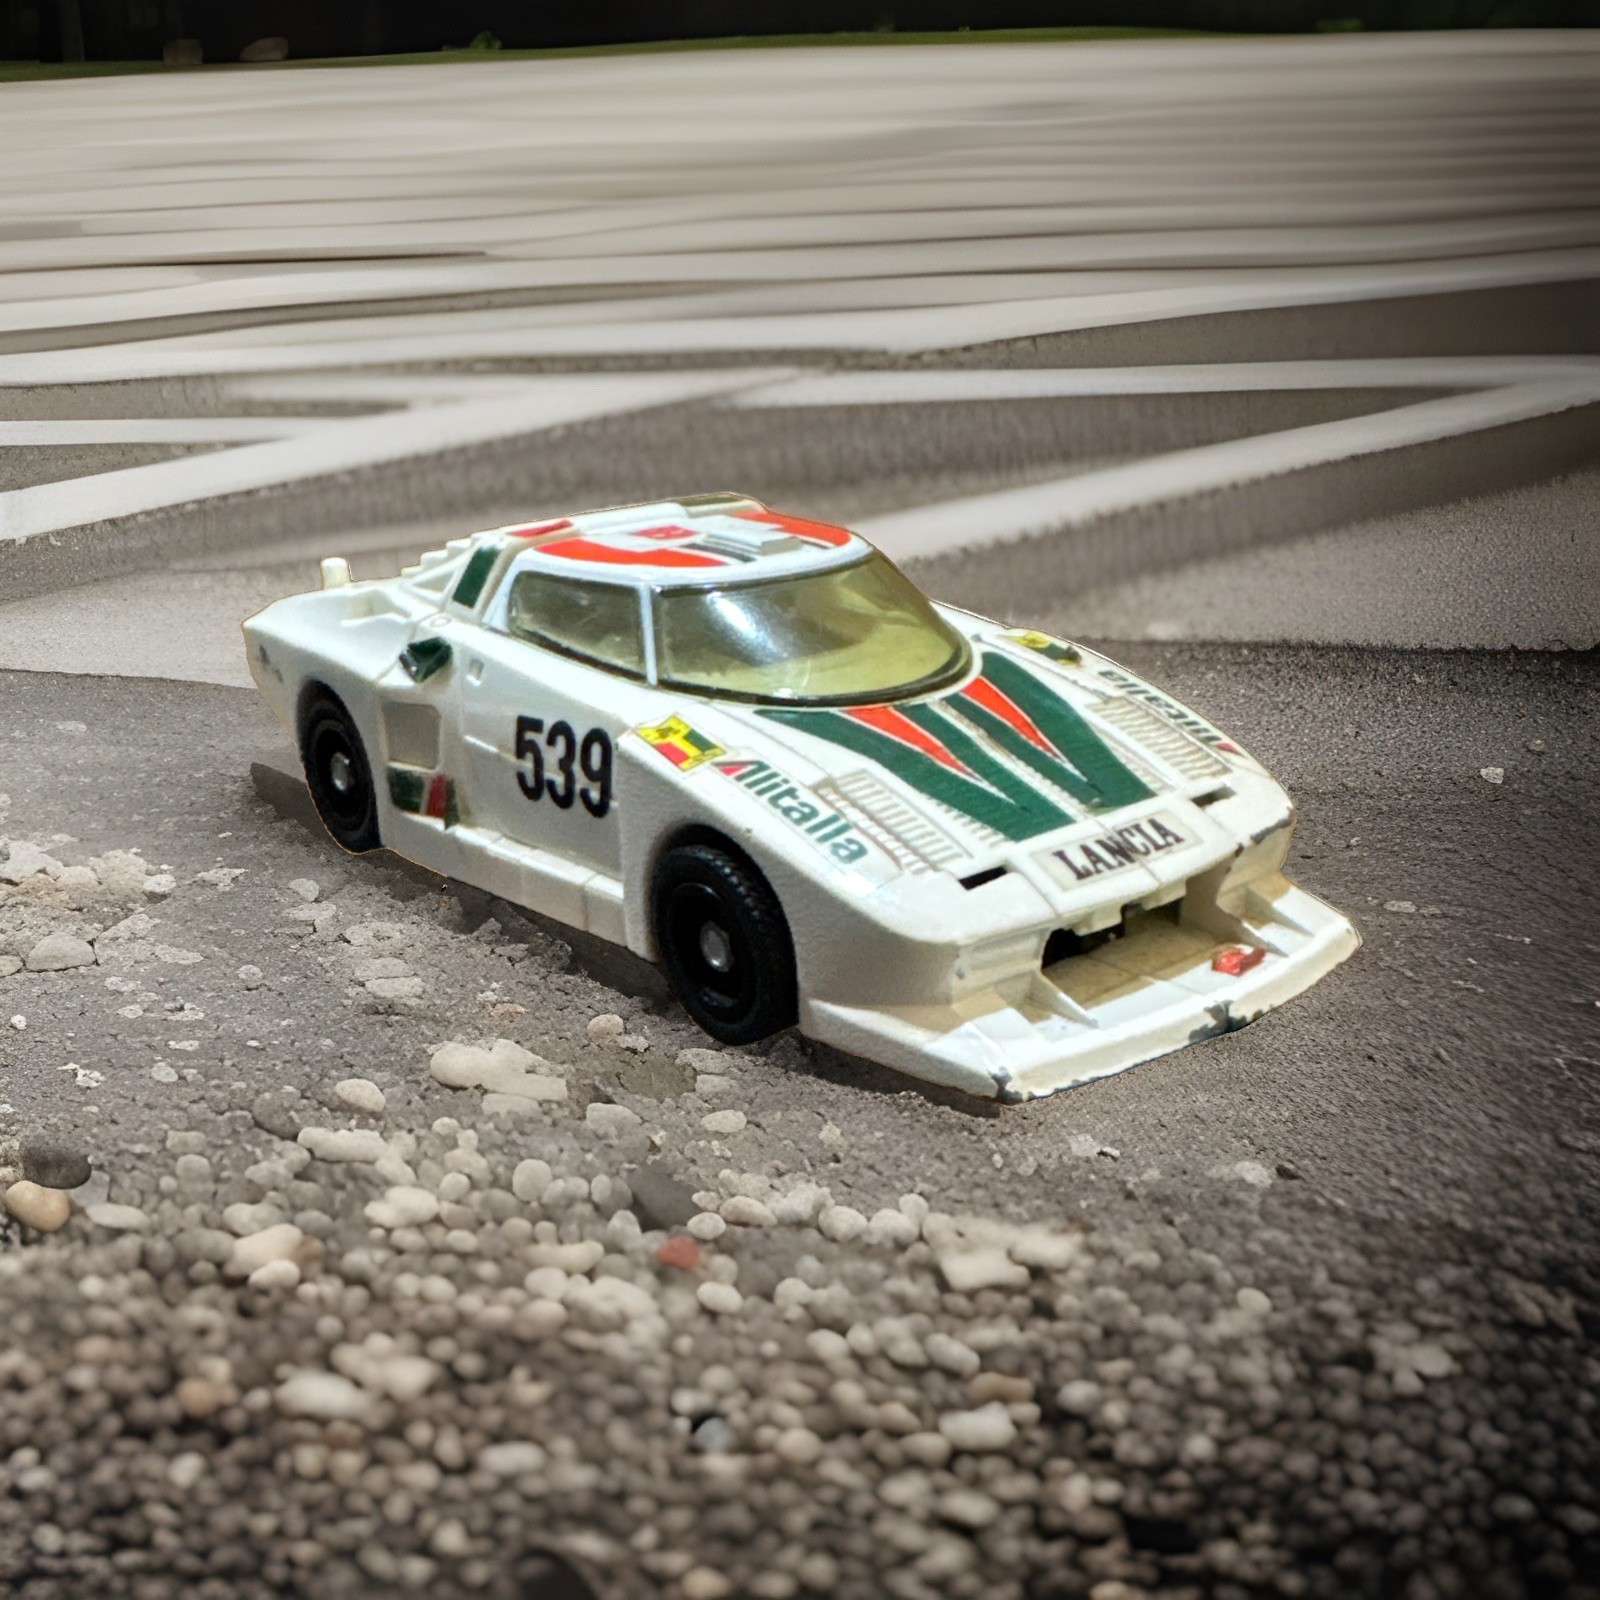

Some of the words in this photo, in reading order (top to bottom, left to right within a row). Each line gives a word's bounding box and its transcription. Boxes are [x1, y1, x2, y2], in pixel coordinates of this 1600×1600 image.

[515, 715, 613, 818] 539
[712, 760, 869, 865] Alitalia
[1052, 818, 1185, 881] LANCIA
